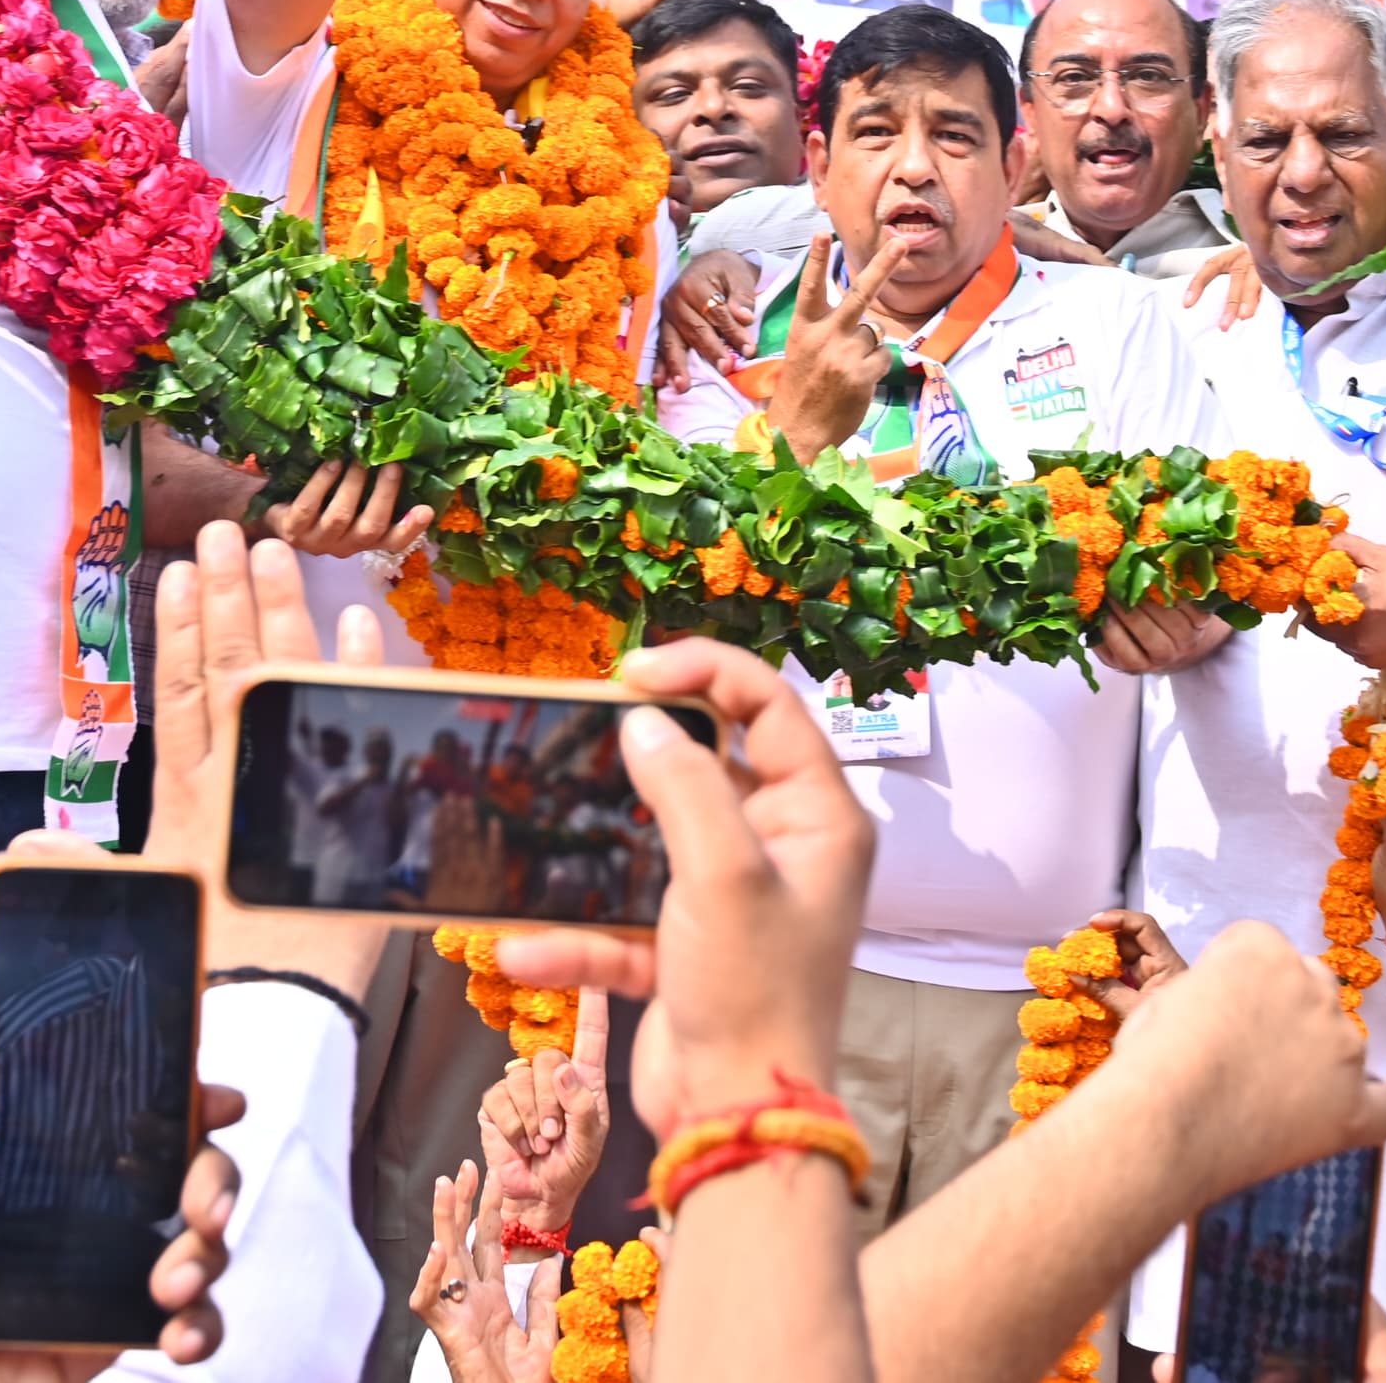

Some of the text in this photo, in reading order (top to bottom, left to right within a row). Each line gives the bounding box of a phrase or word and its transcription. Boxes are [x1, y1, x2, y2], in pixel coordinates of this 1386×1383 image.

[1019, 348, 1074, 380] DELHI
[1031, 390, 1086, 419] YATRA
[857, 713, 899, 724] YATRA
